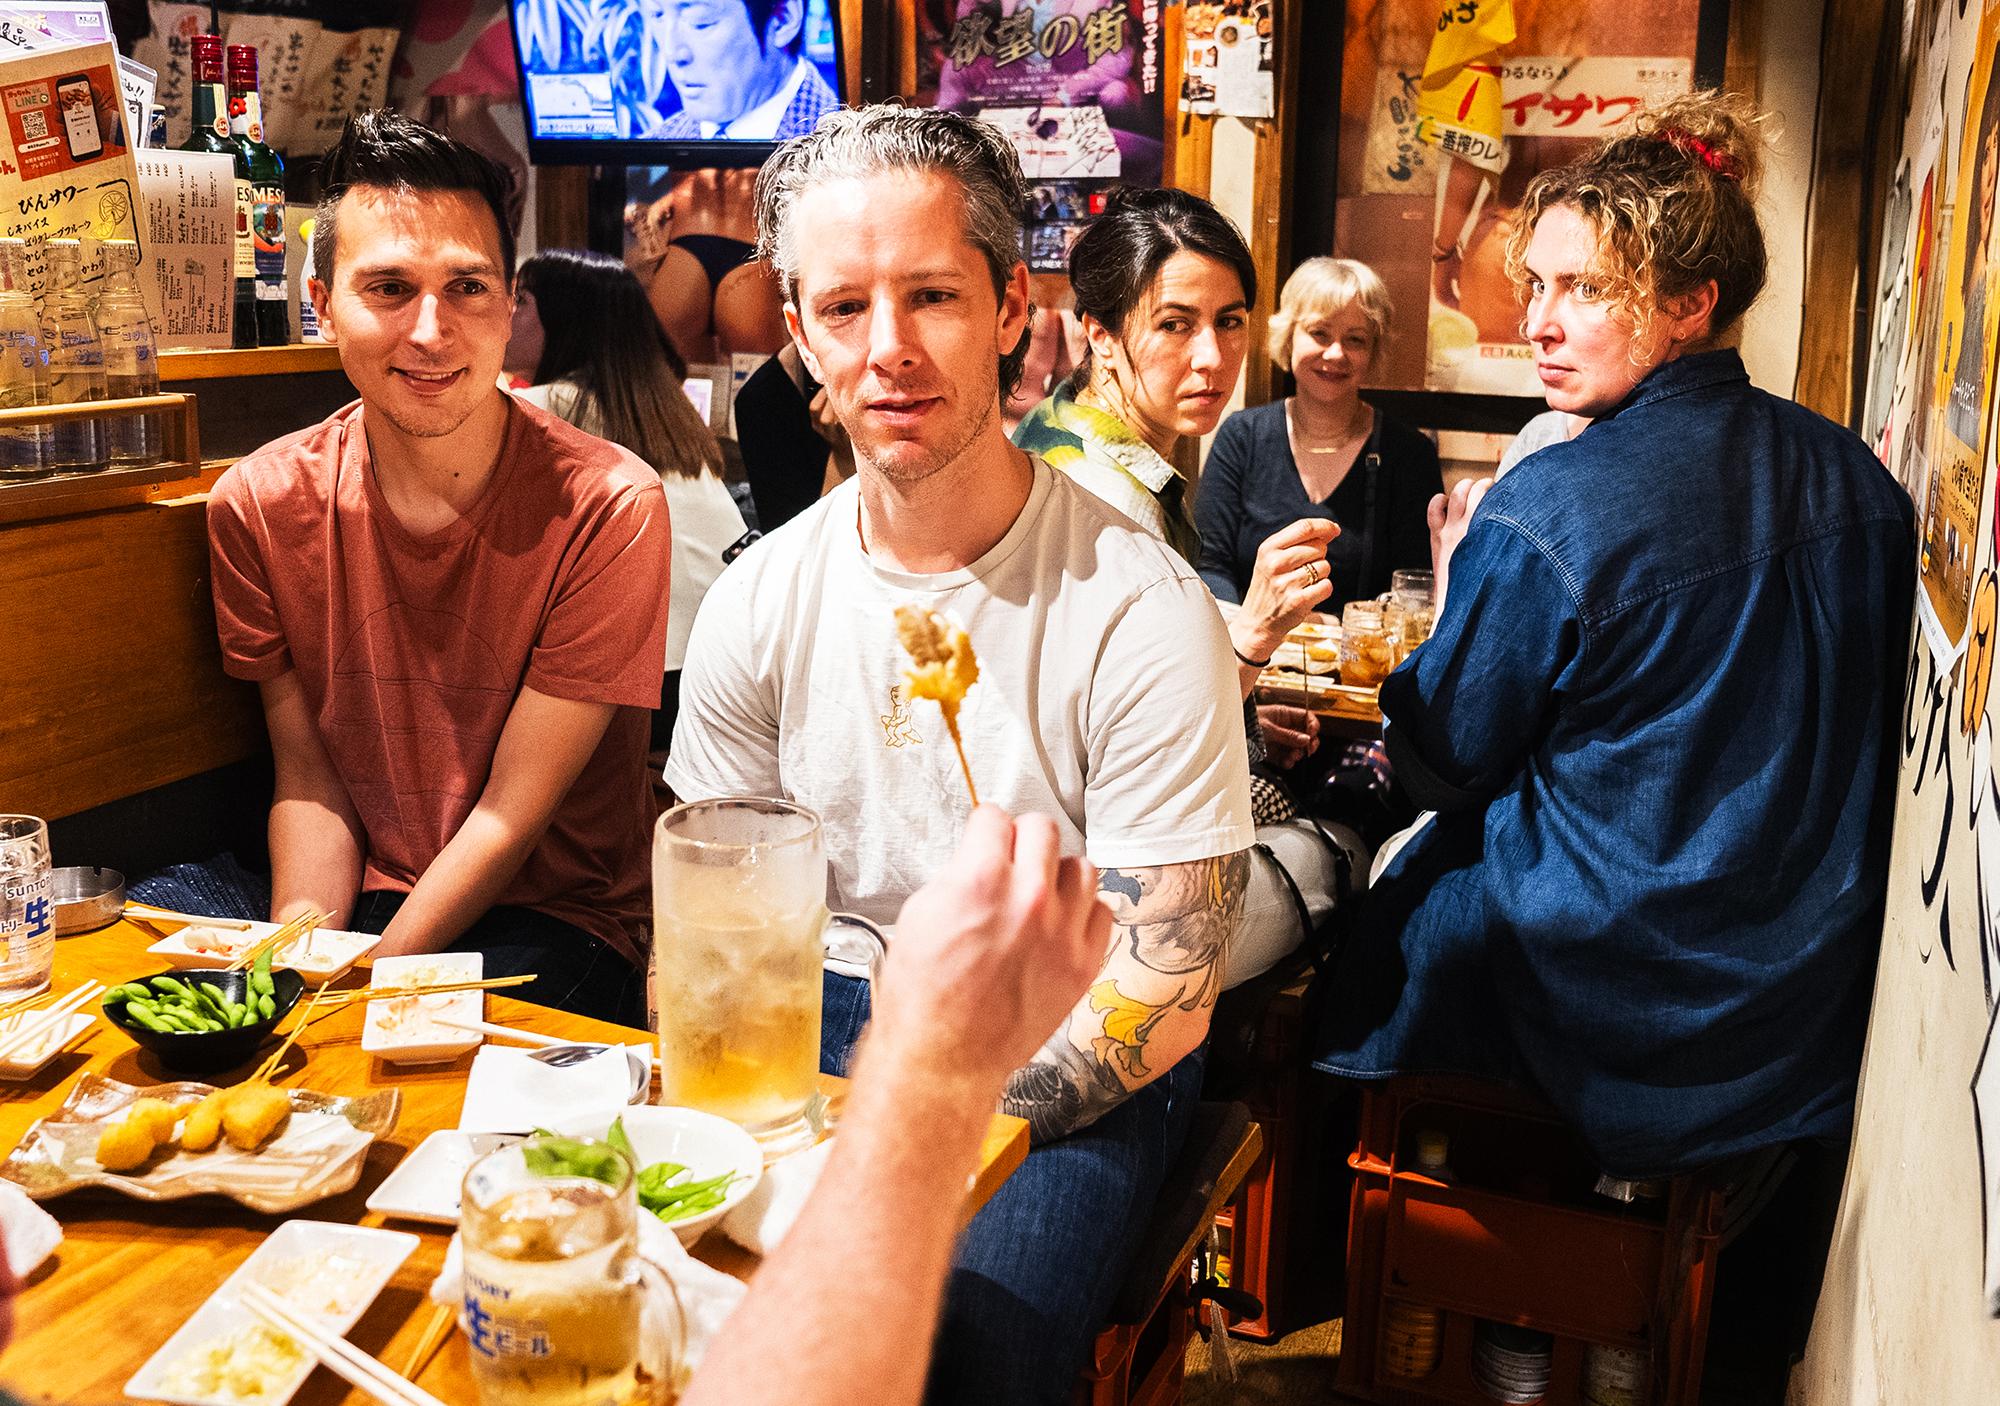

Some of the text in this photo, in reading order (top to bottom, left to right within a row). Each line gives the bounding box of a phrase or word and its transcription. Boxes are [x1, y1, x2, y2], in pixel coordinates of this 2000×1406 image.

[950, 3, 1127, 72] 欲望の街
[15, 95, 38, 108] LINE
[18, 185, 89, 215] びんサワー
[7, 216, 49, 237] しそバイス
[178, 223, 186, 243] Soft
[25, 895, 51, 939] 生
